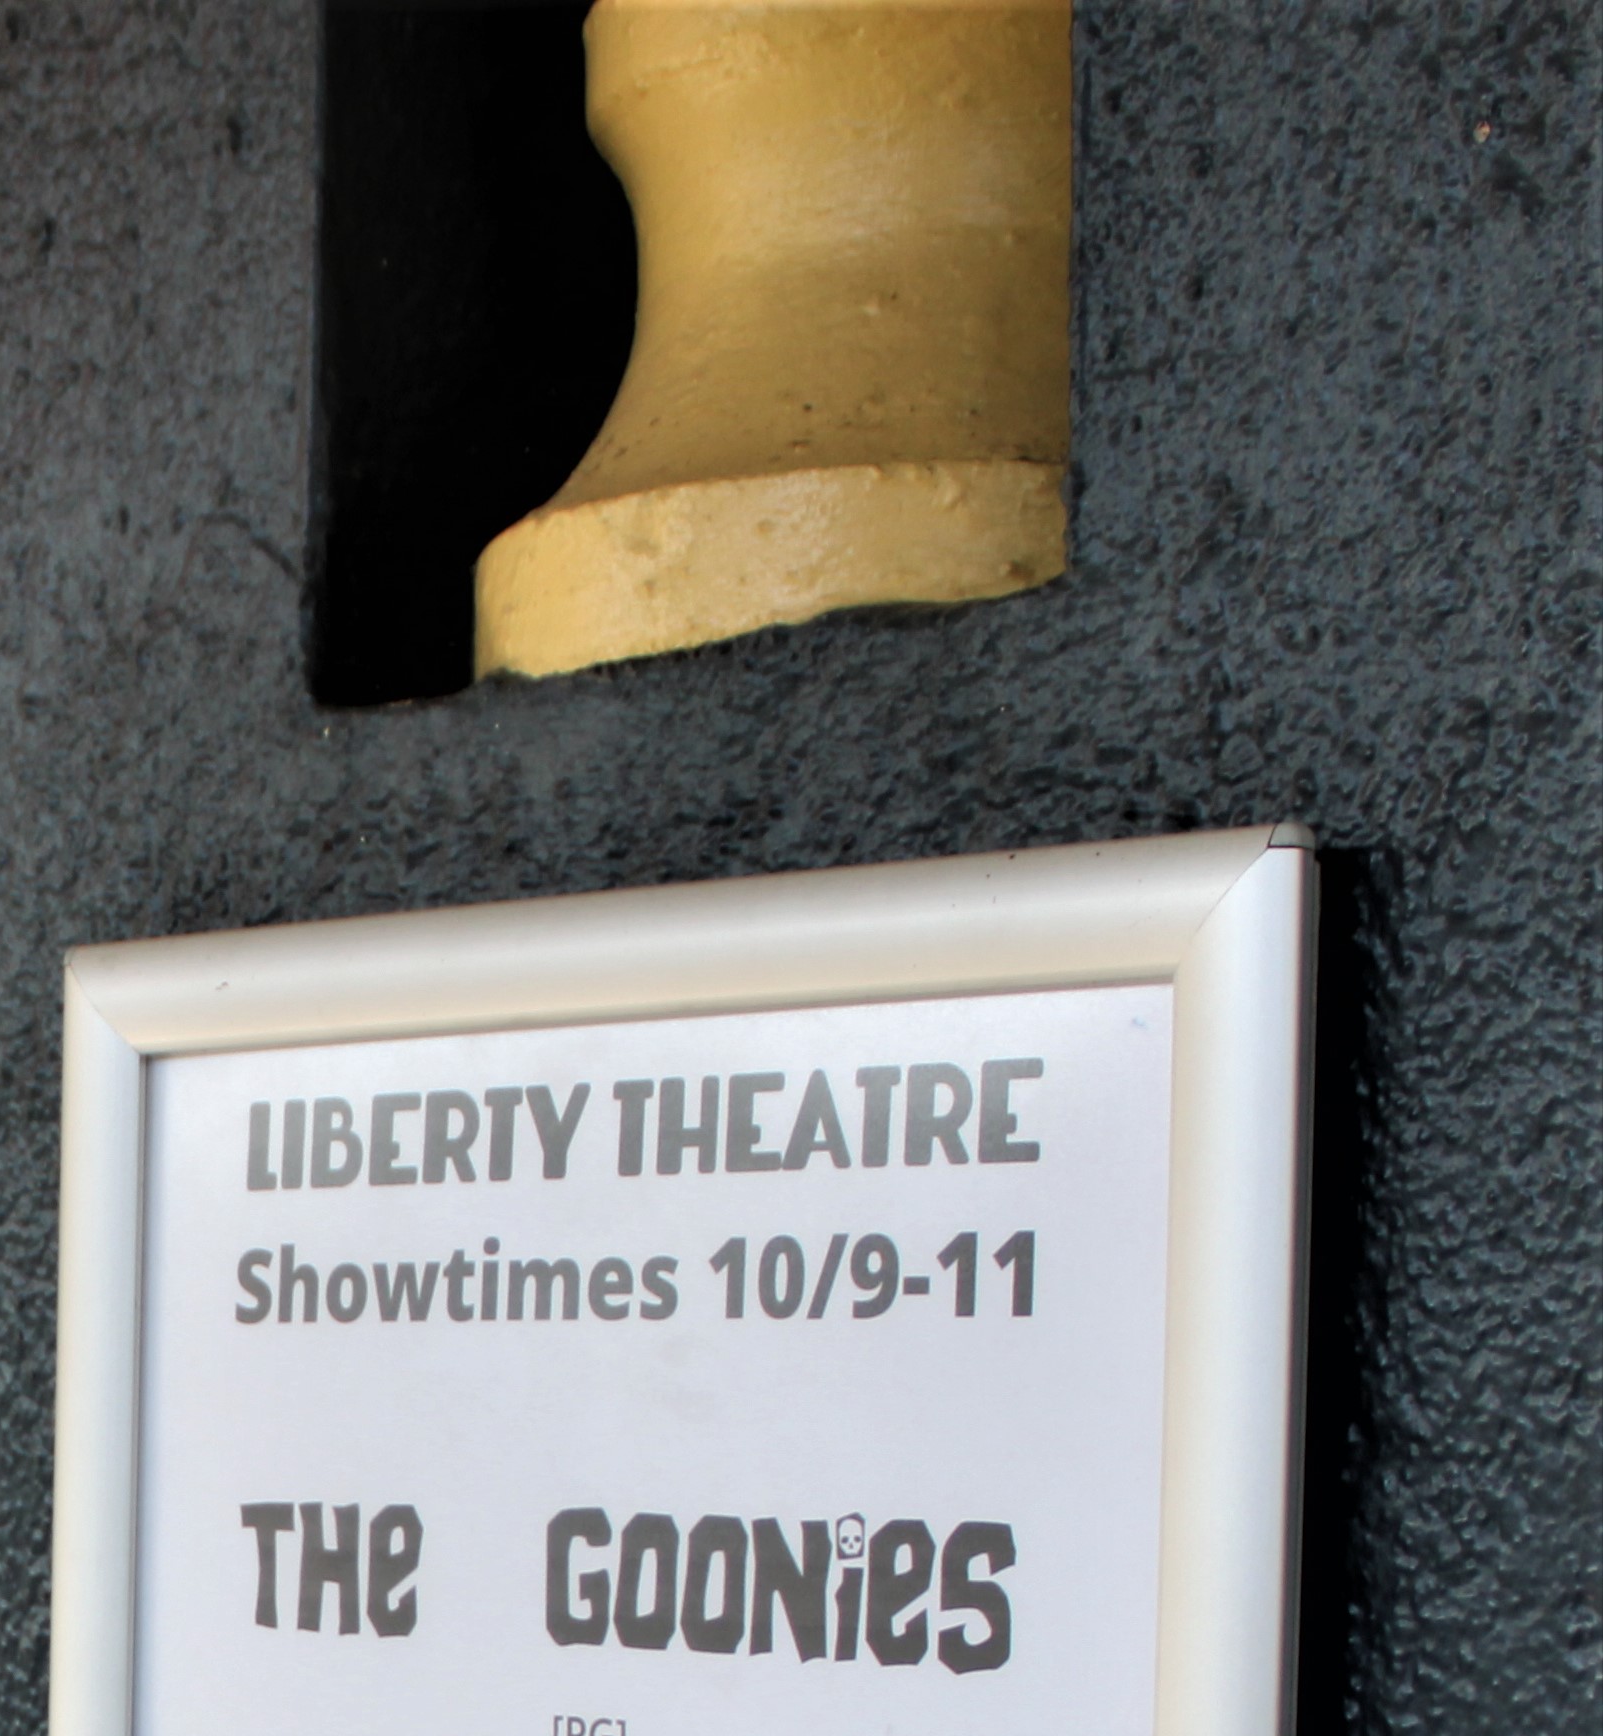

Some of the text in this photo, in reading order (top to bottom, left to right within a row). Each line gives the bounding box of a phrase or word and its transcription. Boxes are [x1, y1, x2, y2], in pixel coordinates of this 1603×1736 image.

[246, 1058, 1044, 1191] LIBERTY THEATRE
[235, 1229, 1037, 1325] Showtimes 10/9-11
